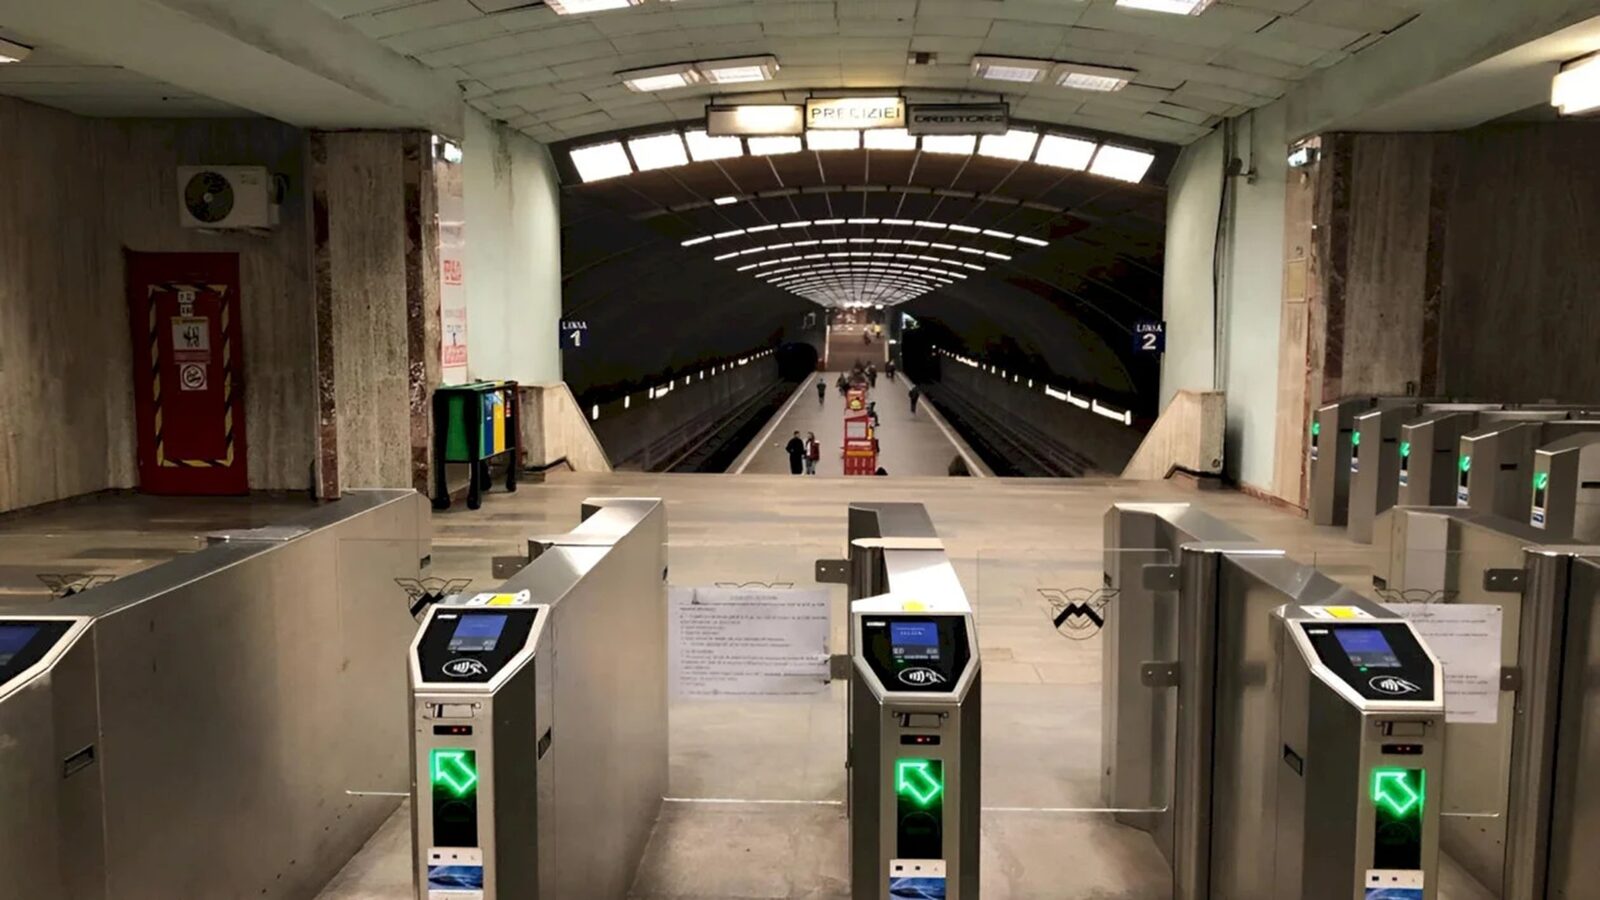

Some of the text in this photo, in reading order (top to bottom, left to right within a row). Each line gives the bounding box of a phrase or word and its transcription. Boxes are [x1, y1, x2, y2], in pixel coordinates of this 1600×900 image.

[811, 107, 900, 119] PRECIZIEI
[570, 330, 580, 346] 1
[1142, 333, 1156, 349] 2
